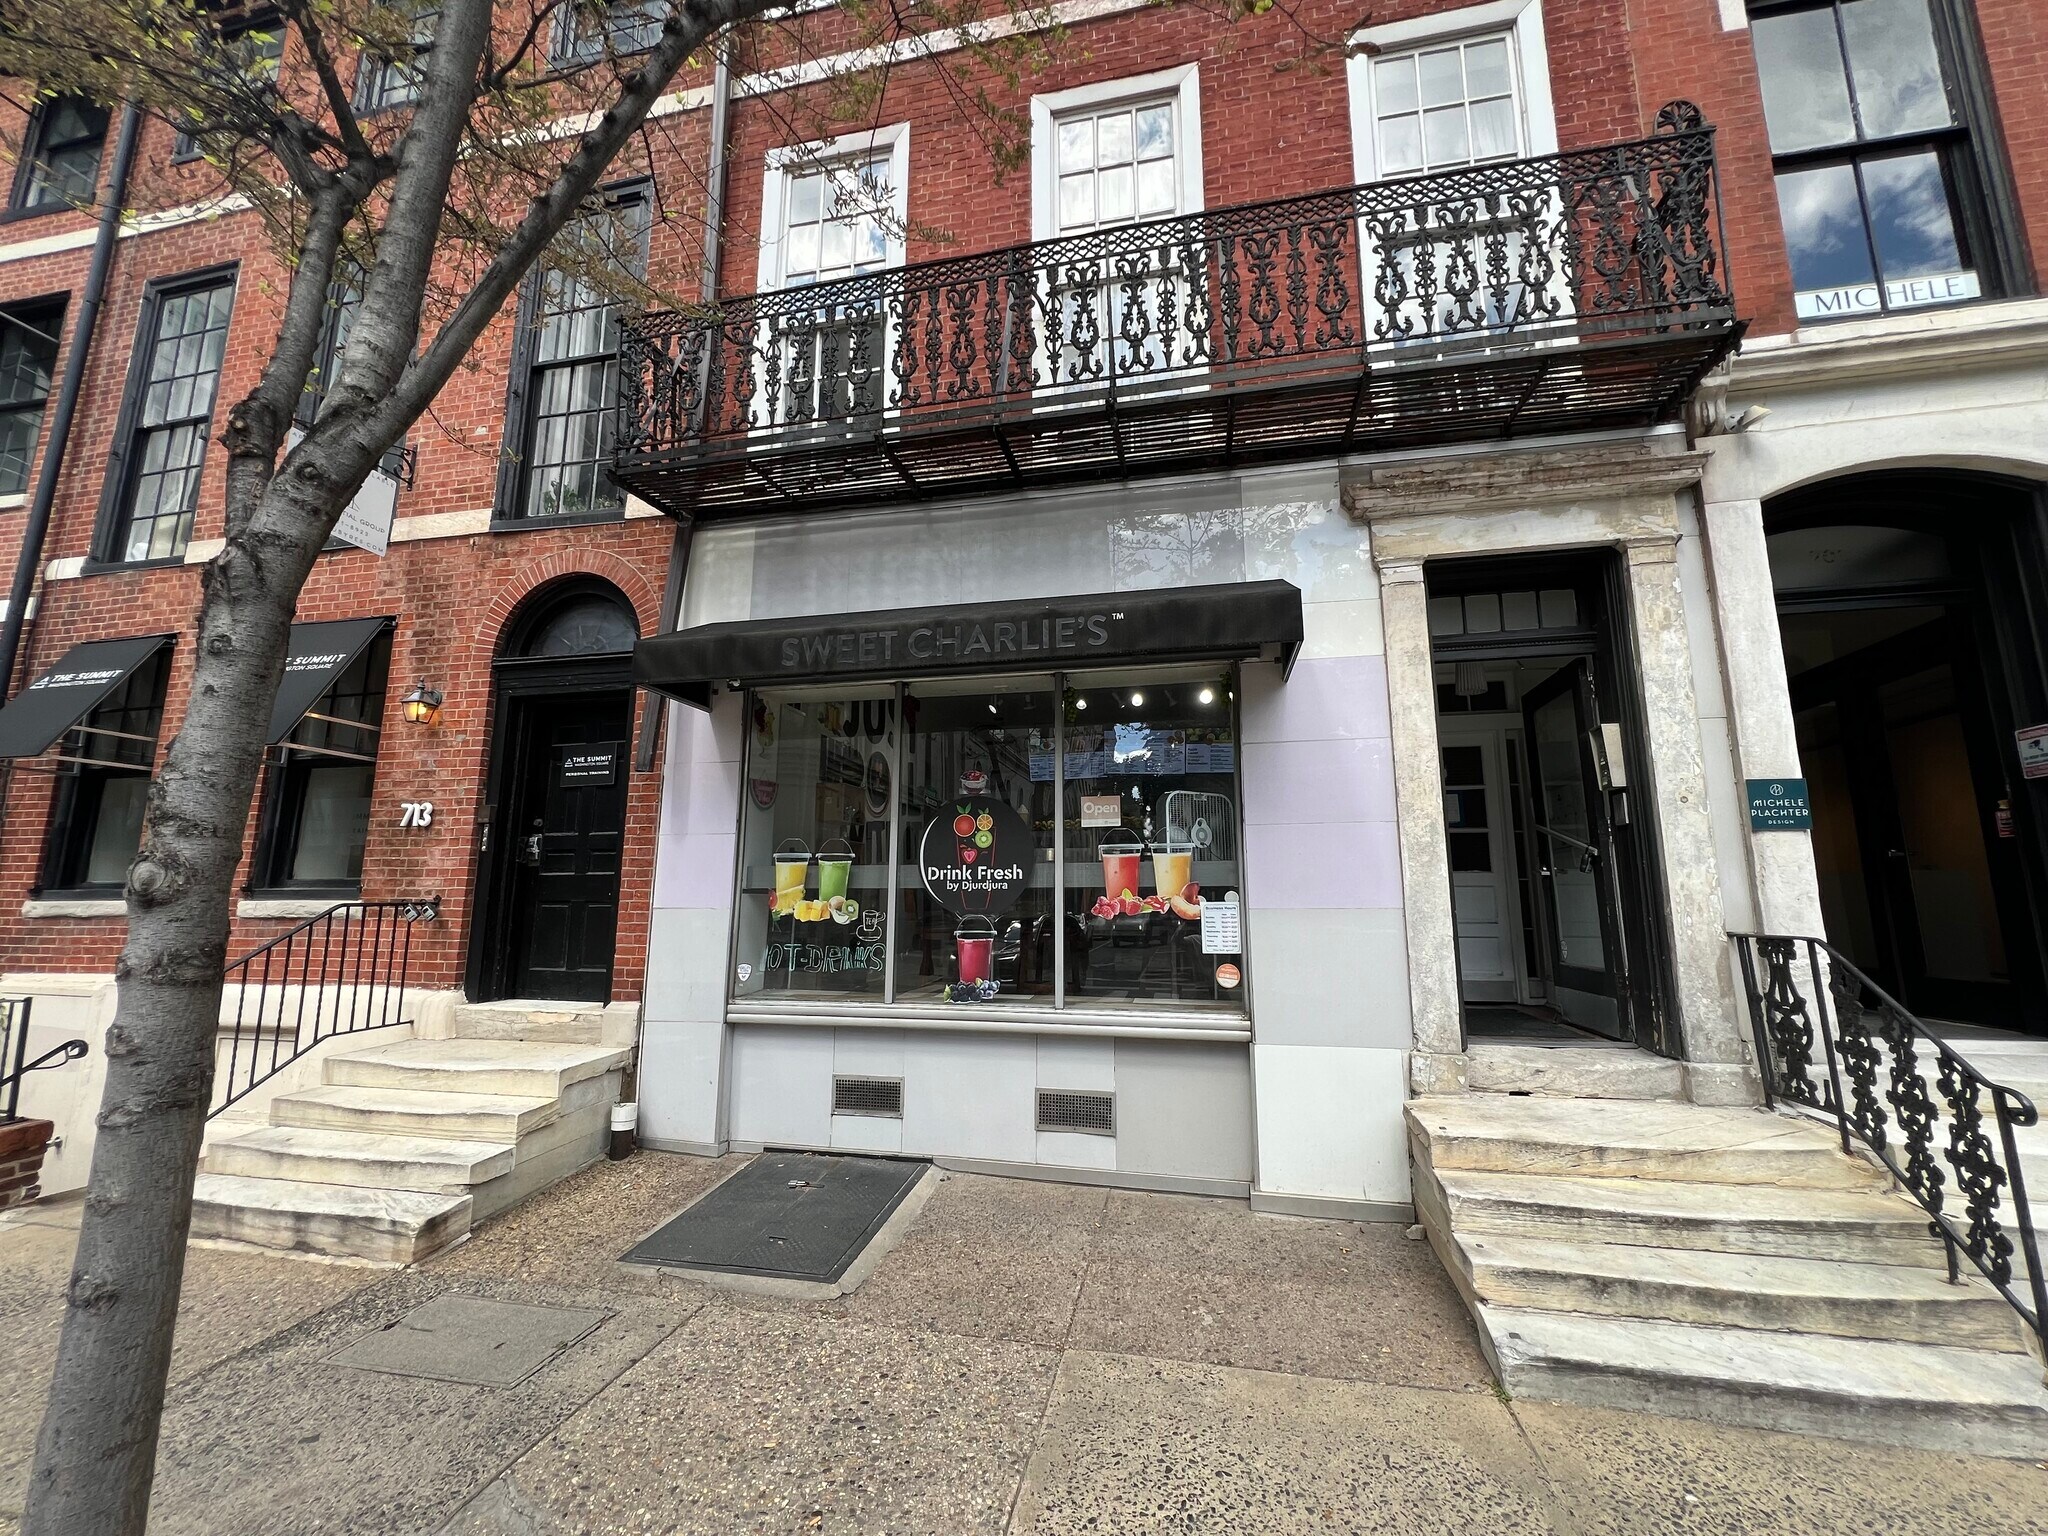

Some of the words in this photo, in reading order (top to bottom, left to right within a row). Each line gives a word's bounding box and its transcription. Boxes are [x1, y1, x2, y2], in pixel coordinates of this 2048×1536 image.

[1815, 276, 1965, 313] MICHELE
[360, 518, 385, 534] GROUP
[781, 630, 898, 667] SWEET
[907, 614, 1109, 659] CHARLIE'S
[293, 653, 346, 665] SUMMIT
[51, 673, 77, 682] THE
[76, 669, 124, 680] SUMMIT
[1082, 801, 1119, 817] Open
[1753, 799, 1805, 807] MICHELE
[400, 802, 434, 827] 713
[1751, 808, 1809, 817] PLACHTER
[927, 864, 973, 881] Drink
[977, 863, 1023, 880] Fresh
[946, 880, 959, 892] by
[962, 880, 1008, 892] Djurdjura
